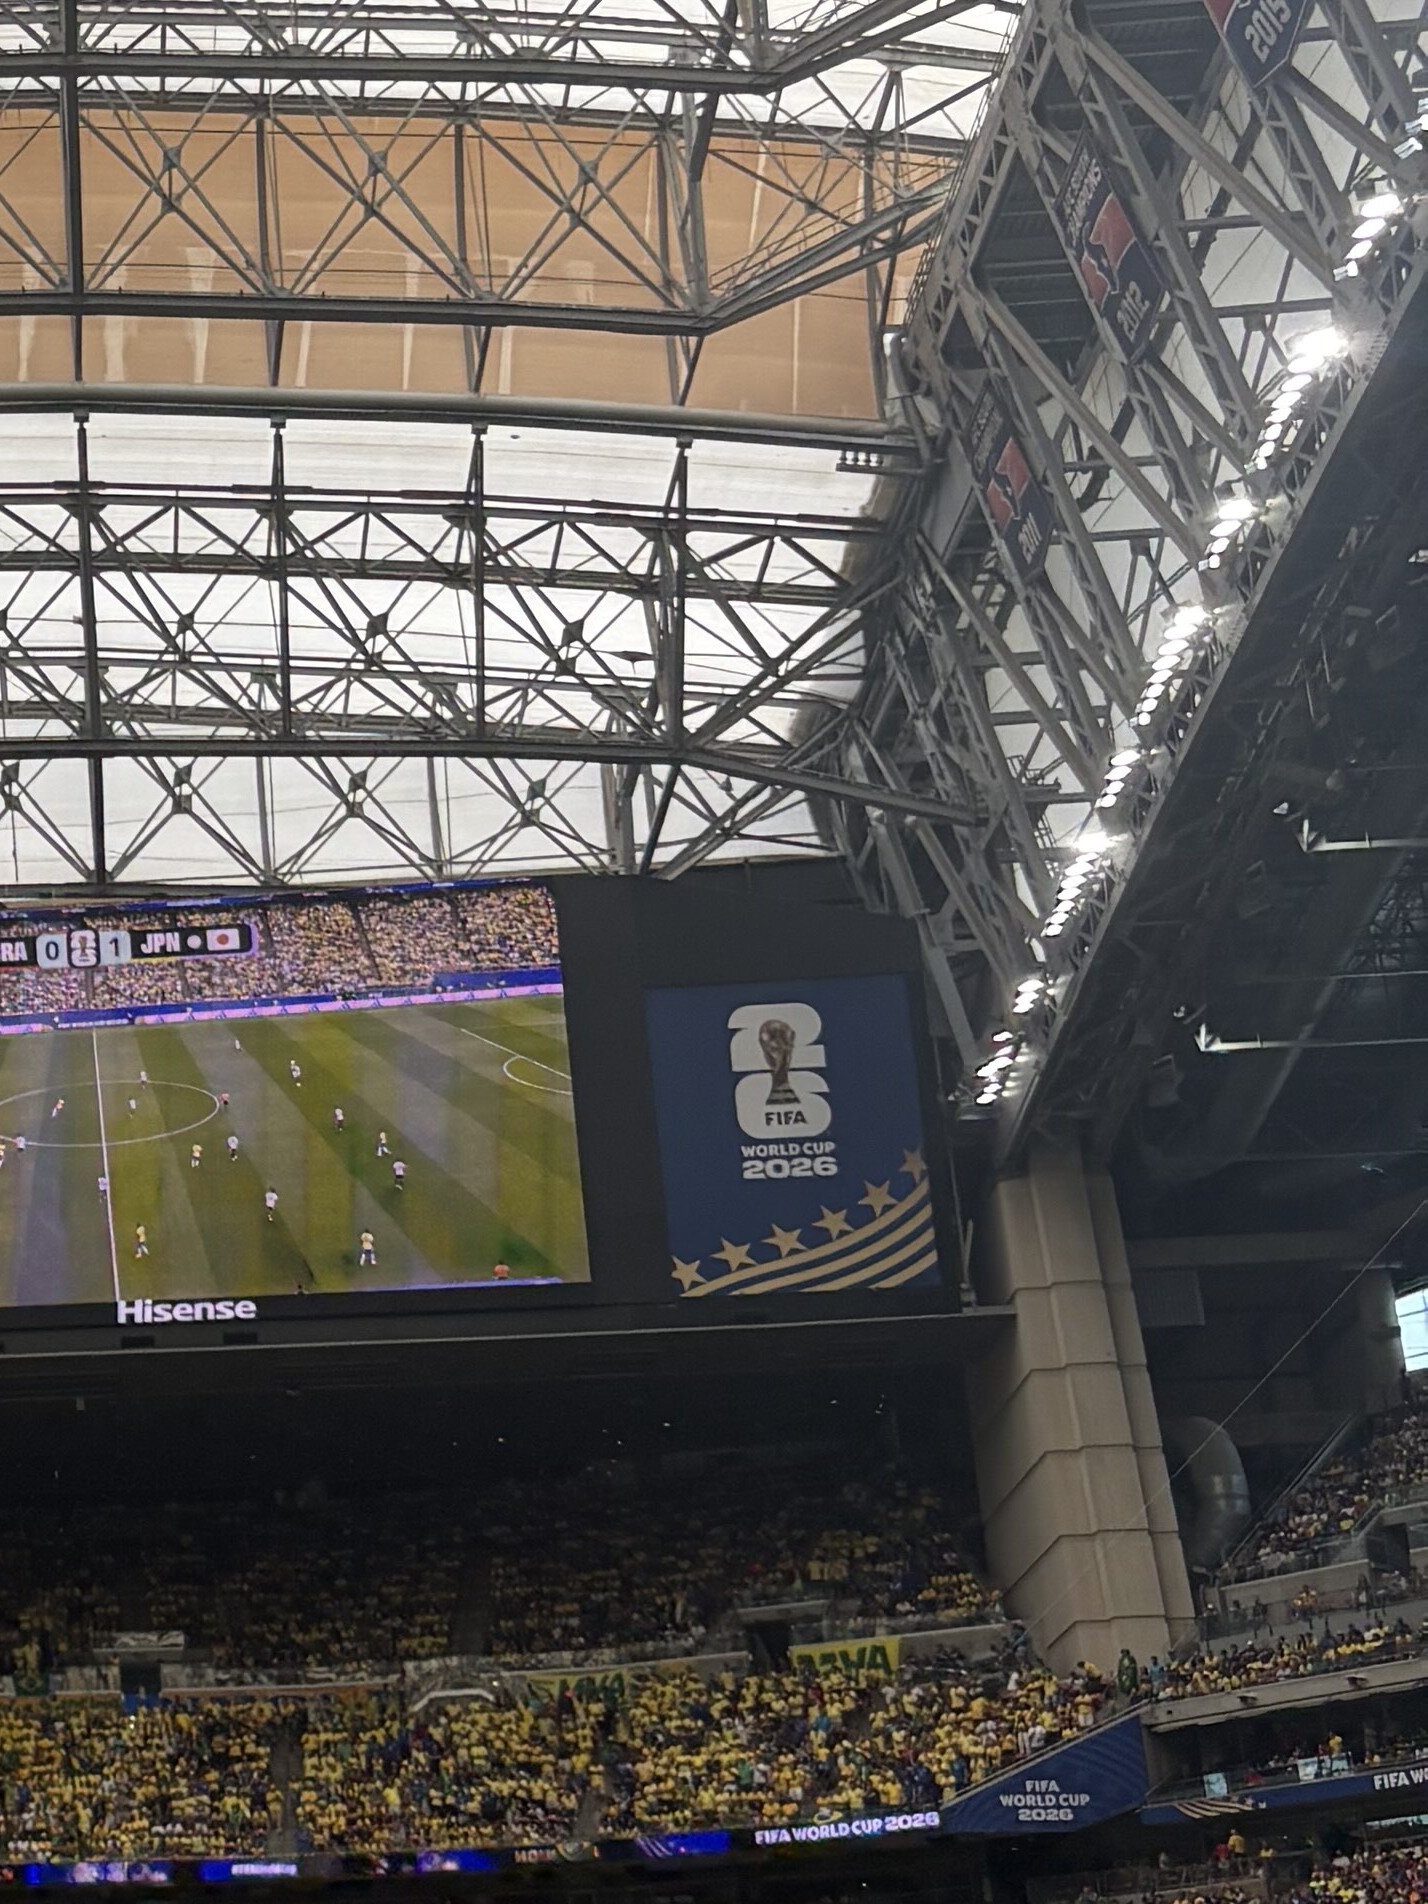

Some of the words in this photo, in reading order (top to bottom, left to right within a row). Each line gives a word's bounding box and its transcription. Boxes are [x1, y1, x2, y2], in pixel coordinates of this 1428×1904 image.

[45, 940, 60, 961] 0
[109, 937, 120, 958] 1
[140, 932, 181, 955] JPN
[764, 1110, 809, 1127] FIFA
[741, 1143, 800, 1158] WORLD
[802, 1141, 836, 1155] CUP
[742, 1156, 838, 1180] 2026
[117, 1299, 257, 1324] Hisense
[1025, 1780, 1061, 1793] FIFA
[1373, 1772, 1410, 1791] FIFA
[999, 1795, 1057, 1807] WORLD
[1059, 1794, 1090, 1807] CUP
[1018, 1809, 1074, 1821] 2026
[755, 1829, 792, 1845] FIFA
[793, 1823, 851, 1841] WORLD
[851, 1819, 883, 1836] CUP
[884, 1811, 940, 1831] 2026
